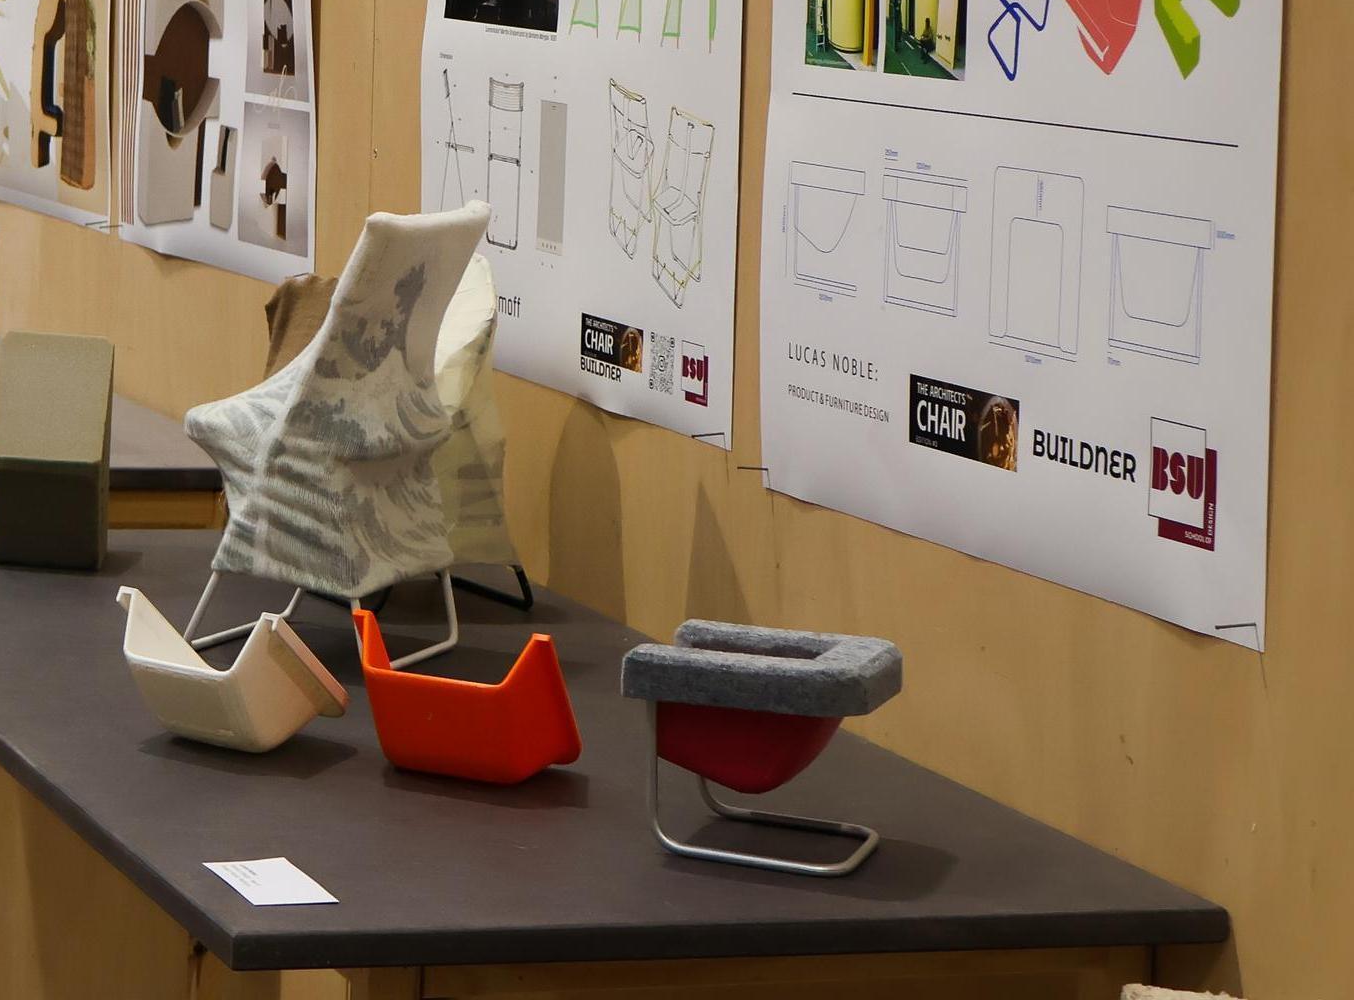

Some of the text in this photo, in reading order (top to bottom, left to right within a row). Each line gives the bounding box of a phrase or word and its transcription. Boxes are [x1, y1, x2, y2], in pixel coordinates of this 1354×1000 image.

[585, 328, 614, 356] CHAIR
[788, 342, 878, 381] LUCAS NOBLE:
[580, 357, 622, 382] BUILDNER
[682, 356, 704, 382] BSU
[788, 384, 818, 404] PRODUCT
[825, 393, 862, 416] FURNITURE
[863, 404, 890, 423] DESIGN
[917, 382, 928, 396] THE
[917, 400, 966, 442] CHAIR
[1032, 429, 1136, 482] BUILDNER
[1152, 446, 1204, 500] BSU
